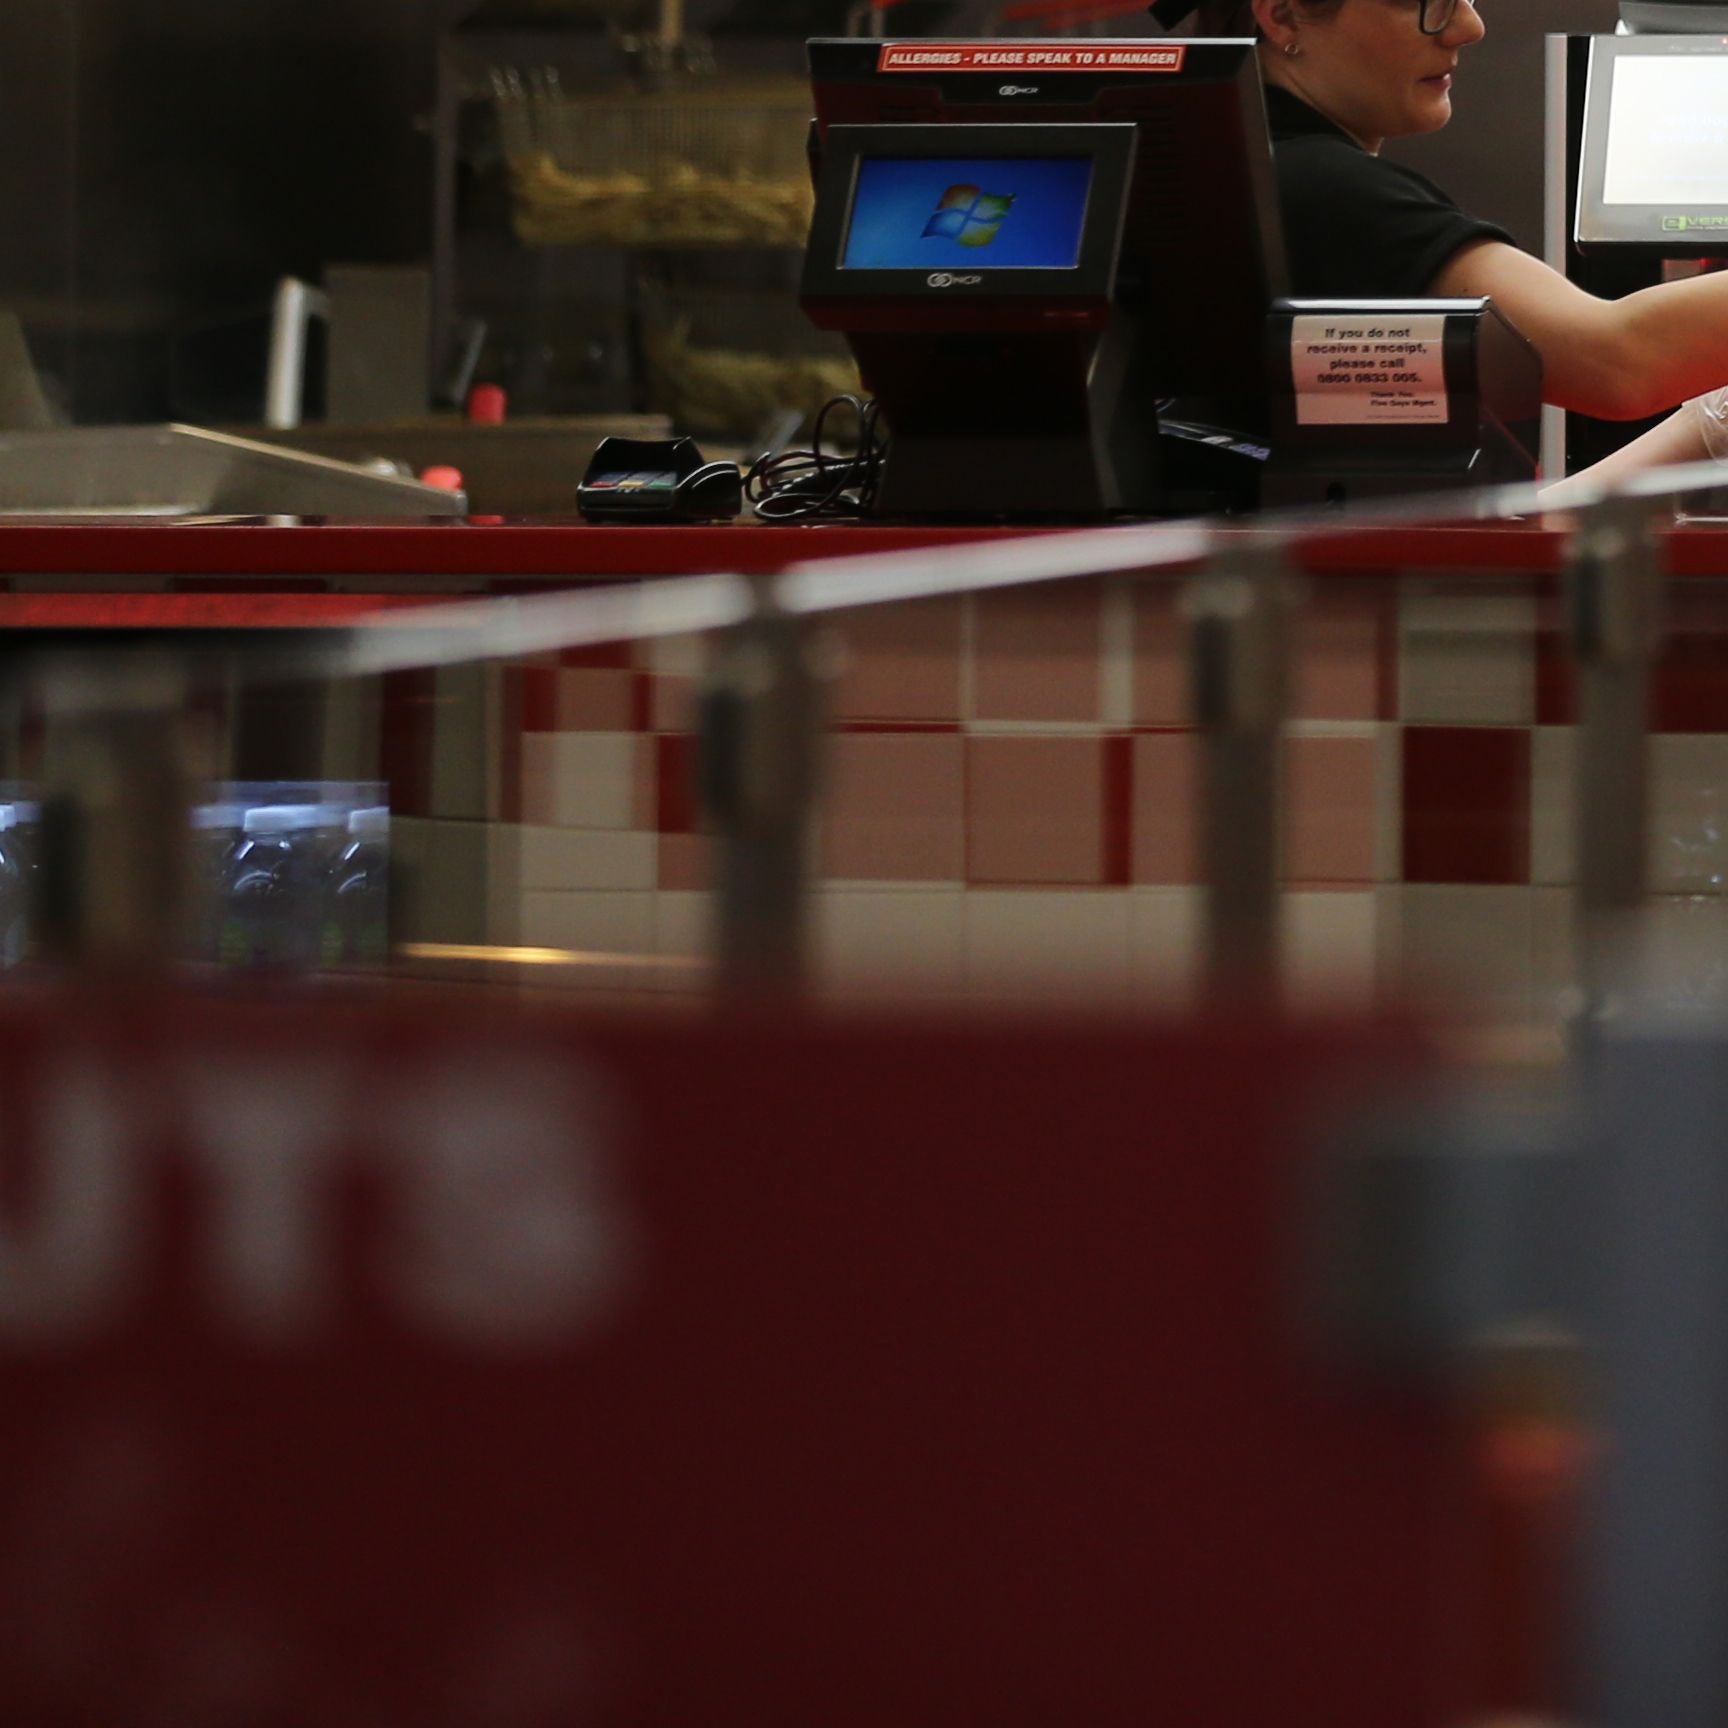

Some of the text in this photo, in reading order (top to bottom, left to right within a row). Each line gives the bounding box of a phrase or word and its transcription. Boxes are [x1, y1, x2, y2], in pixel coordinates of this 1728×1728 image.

[887, 50, 962, 65] ALLERGIES
[972, 52, 1025, 64] PLEASE
[1026, 52, 1073, 64] SPEAK
[1075, 52, 1094, 64] TO
[1095, 52, 1106, 64] A
[1108, 52, 1177, 65] MANAGER
[1324, 327, 1337, 338] If
[1361, 344, 1371, 354] a
